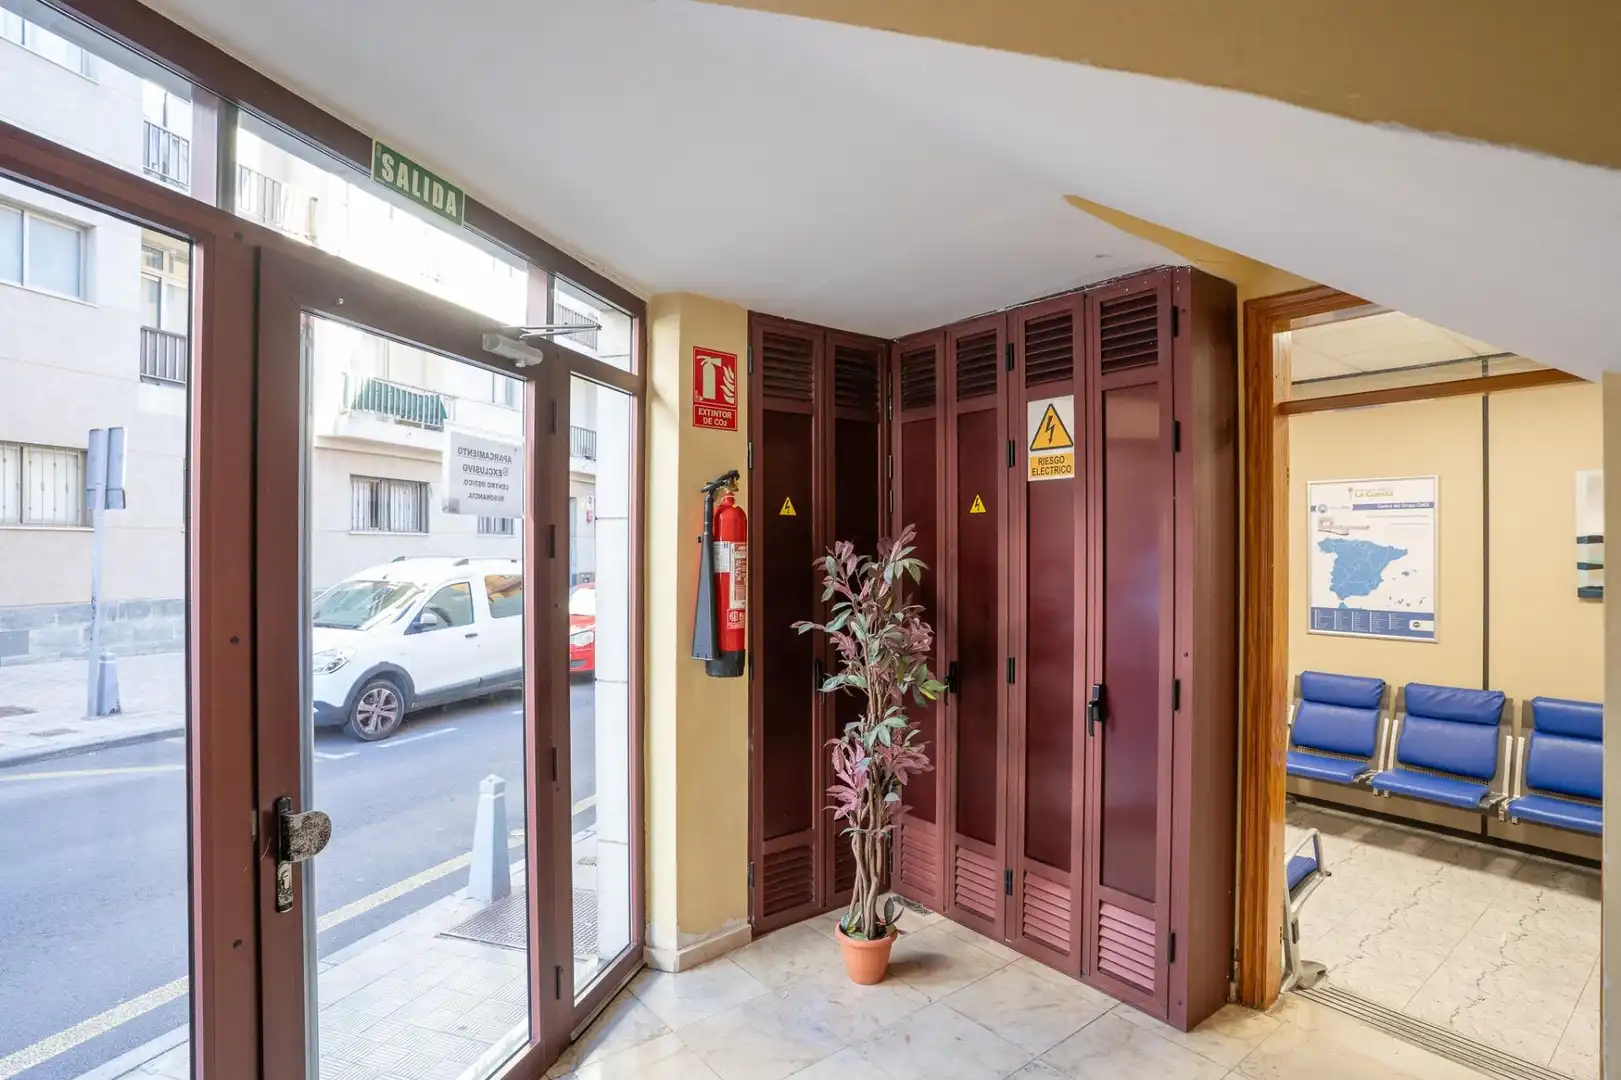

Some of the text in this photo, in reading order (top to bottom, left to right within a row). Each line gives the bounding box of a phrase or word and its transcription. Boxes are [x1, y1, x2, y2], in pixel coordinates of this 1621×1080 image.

[381, 153, 457, 218] SALIDA
[698, 407, 732, 419] EXTINTOR
[702, 417, 713, 426] DE
[1037, 455, 1066, 467] RIESGO
